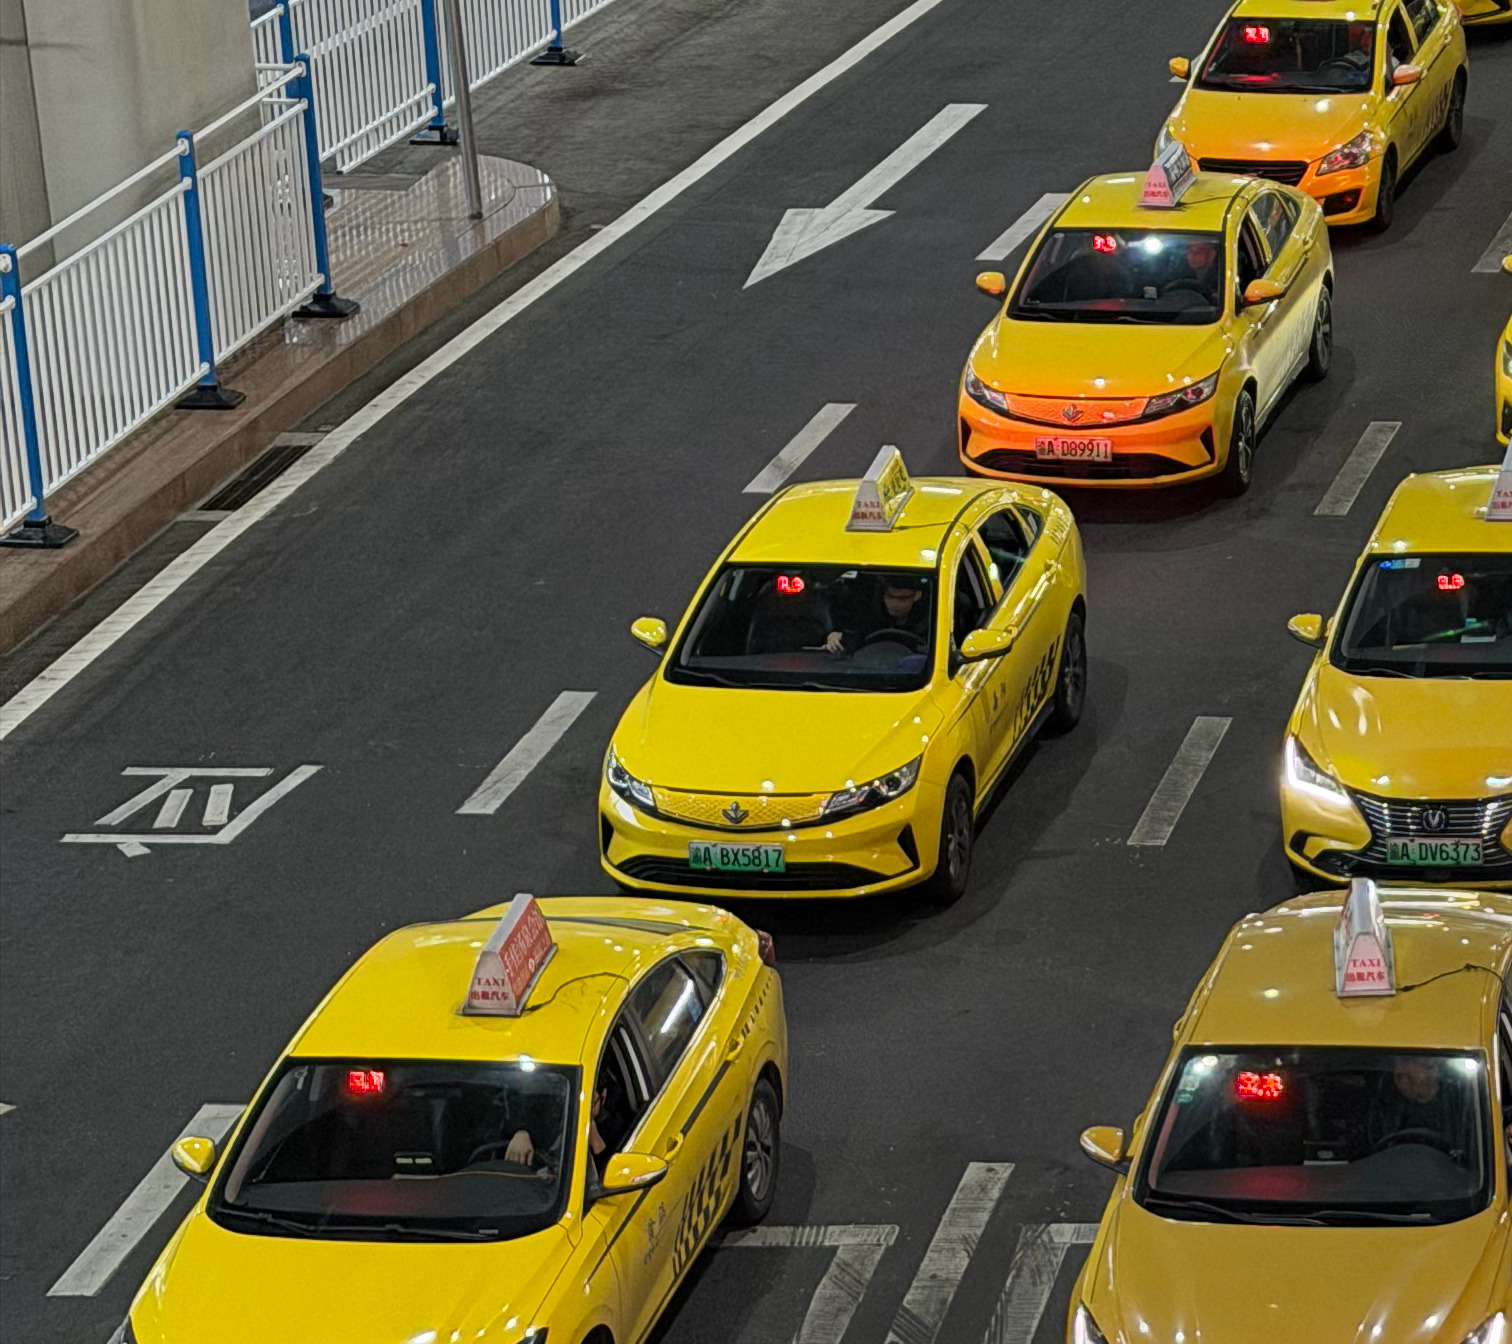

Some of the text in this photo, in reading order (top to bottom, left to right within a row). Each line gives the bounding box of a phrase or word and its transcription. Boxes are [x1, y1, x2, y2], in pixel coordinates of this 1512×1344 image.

[1061, 440, 1109, 459] D89911
[1418, 842, 1481, 862] DV6373
[720, 847, 783, 868] BX5817
[1350, 959, 1381, 968] TAXI
[477, 977, 505, 987] TAXI
[1345, 972, 1385, 982] 出租汽车
[471, 991, 509, 1001] 出租汽车
